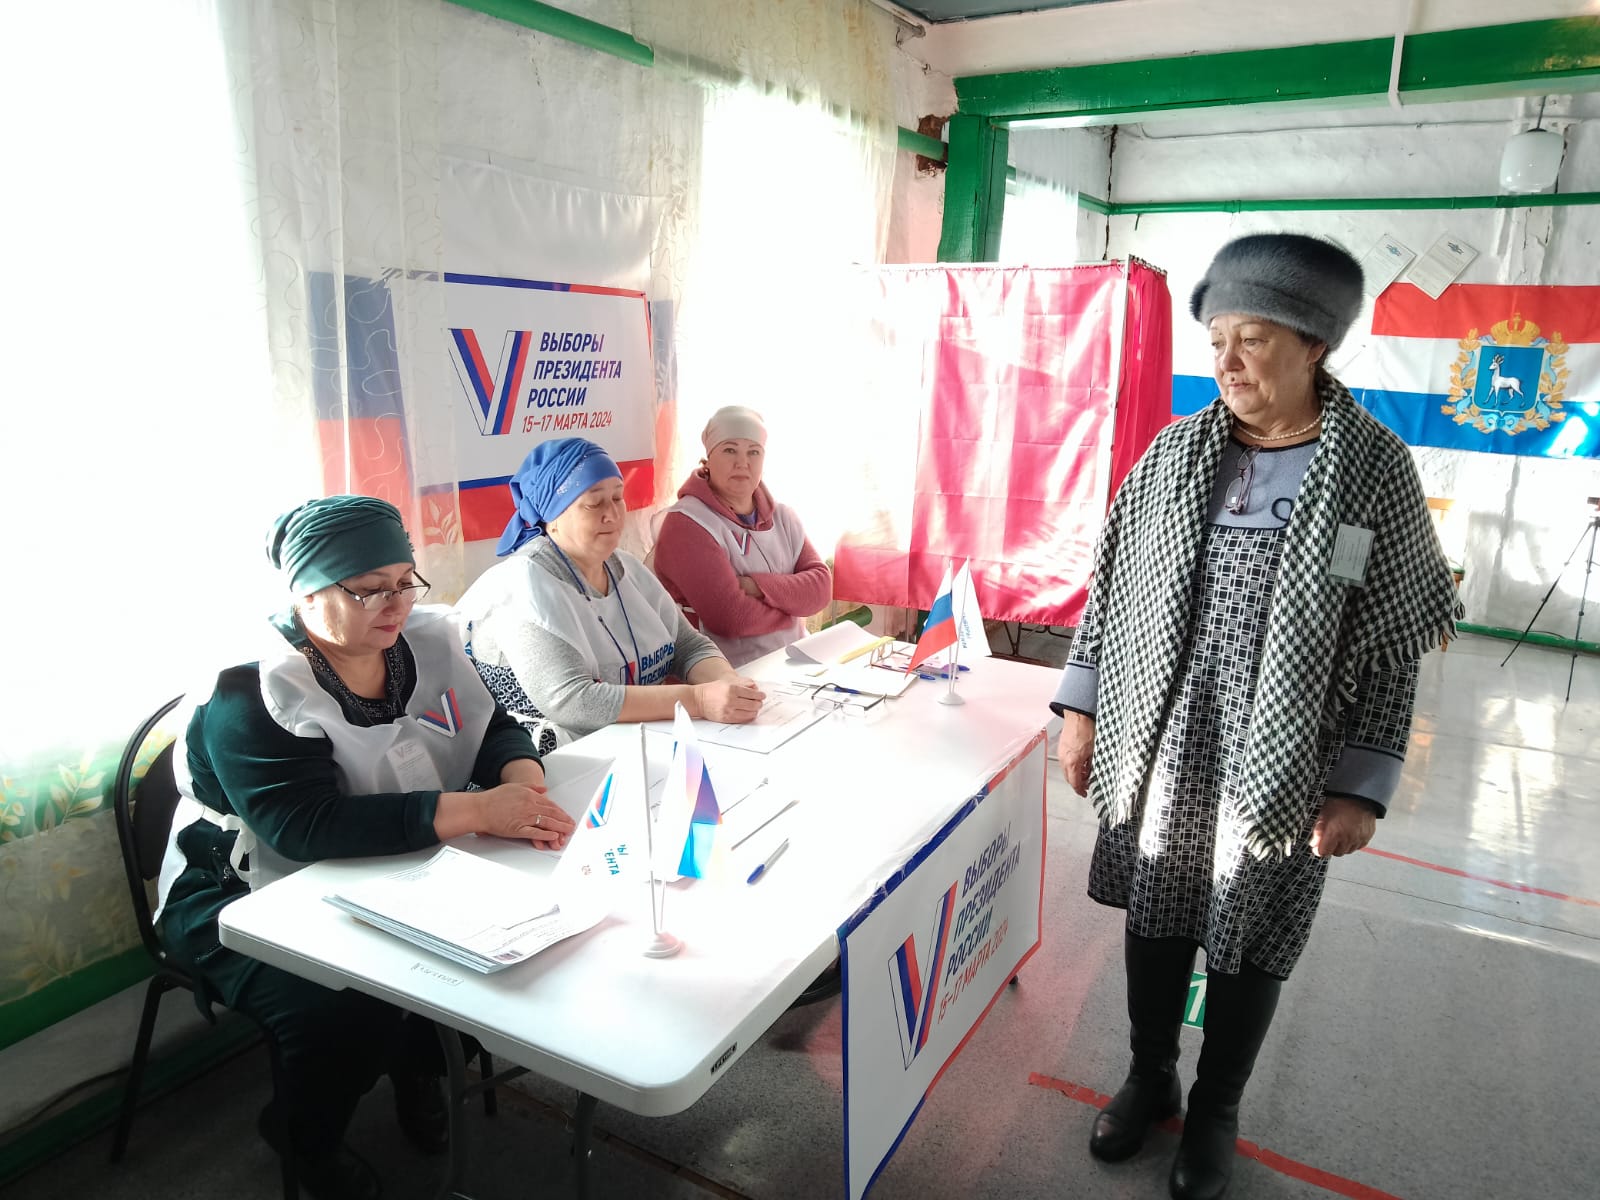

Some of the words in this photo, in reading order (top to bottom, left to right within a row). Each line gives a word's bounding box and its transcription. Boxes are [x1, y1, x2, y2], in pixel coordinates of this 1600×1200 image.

[539, 331, 605, 353] ВЫБОРЫ
[533, 360, 622, 382] ПРЕЗИДЕНТА
[526, 387, 587, 408] РОССИИ
[553, 412, 588, 431] МАРТА
[589, 410, 612, 428] 2024
[962, 820, 1011, 898] ВЫБОРЫ
[953, 839, 1020, 943] ПРЕЗИДЕНТА
[945, 904, 994, 987] РОССИИ
[961, 938, 992, 993] МАРТА
[990, 915, 1009, 957] 2024
